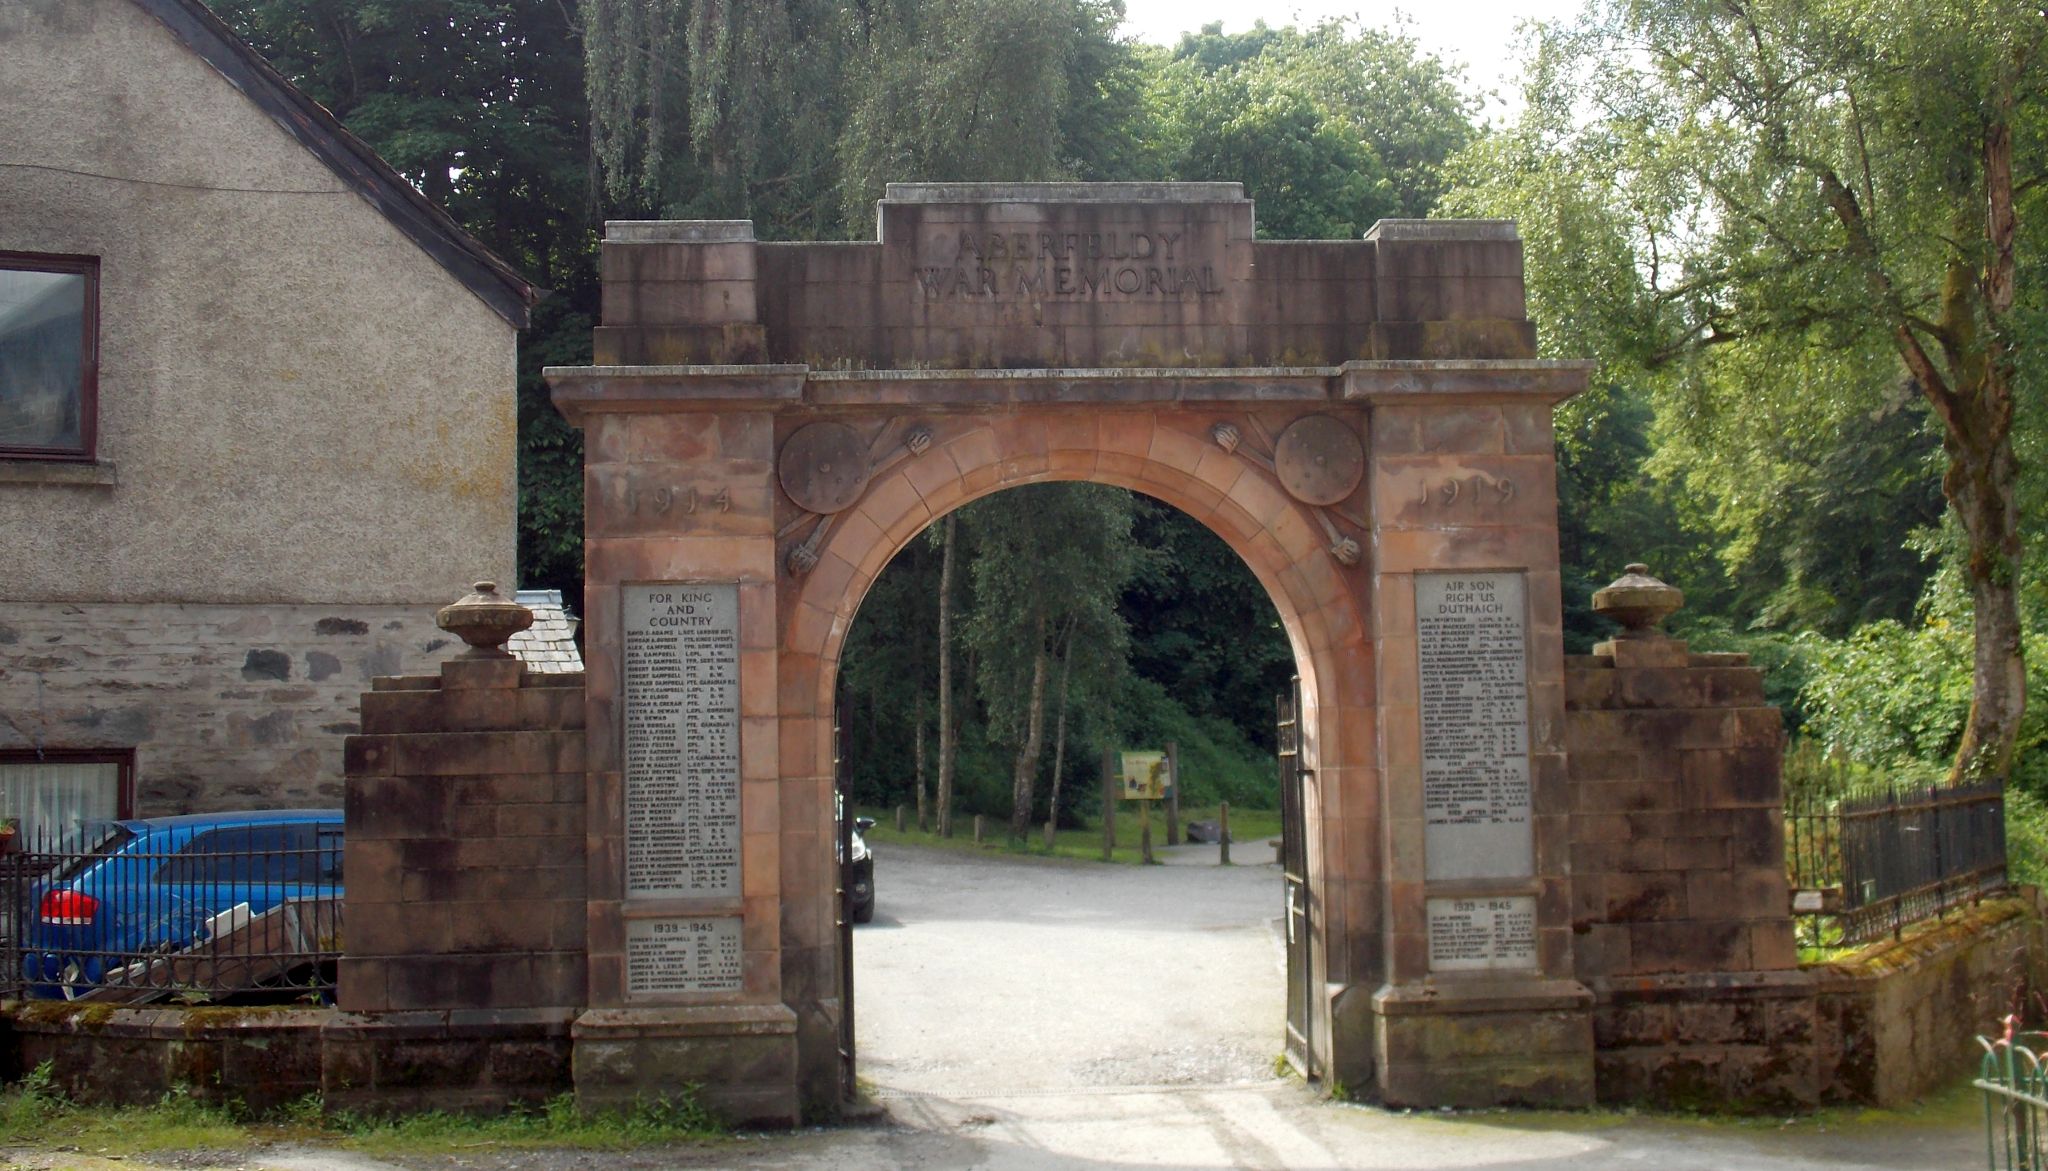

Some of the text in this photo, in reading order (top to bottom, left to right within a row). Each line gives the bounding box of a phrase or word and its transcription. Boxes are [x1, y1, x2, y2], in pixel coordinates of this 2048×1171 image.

[958, 233, 1182, 260] ABERFELDY
[916, 266, 1224, 298] WAR MEMORIAL
[1419, 475, 1514, 505] 1919
[628, 486, 732, 514] 1914
[1446, 581, 1495, 591] AIR SON
[649, 593, 712, 604] FOR KING
[1446, 593, 1474, 602] RIGH
[666, 606, 694, 614] AND
[1440, 604, 1503, 614] DUTHAICH
[650, 616, 713, 626] COUNTRY
[654, 924, 678, 933] 1939
[690, 923, 713, 932] 1945
